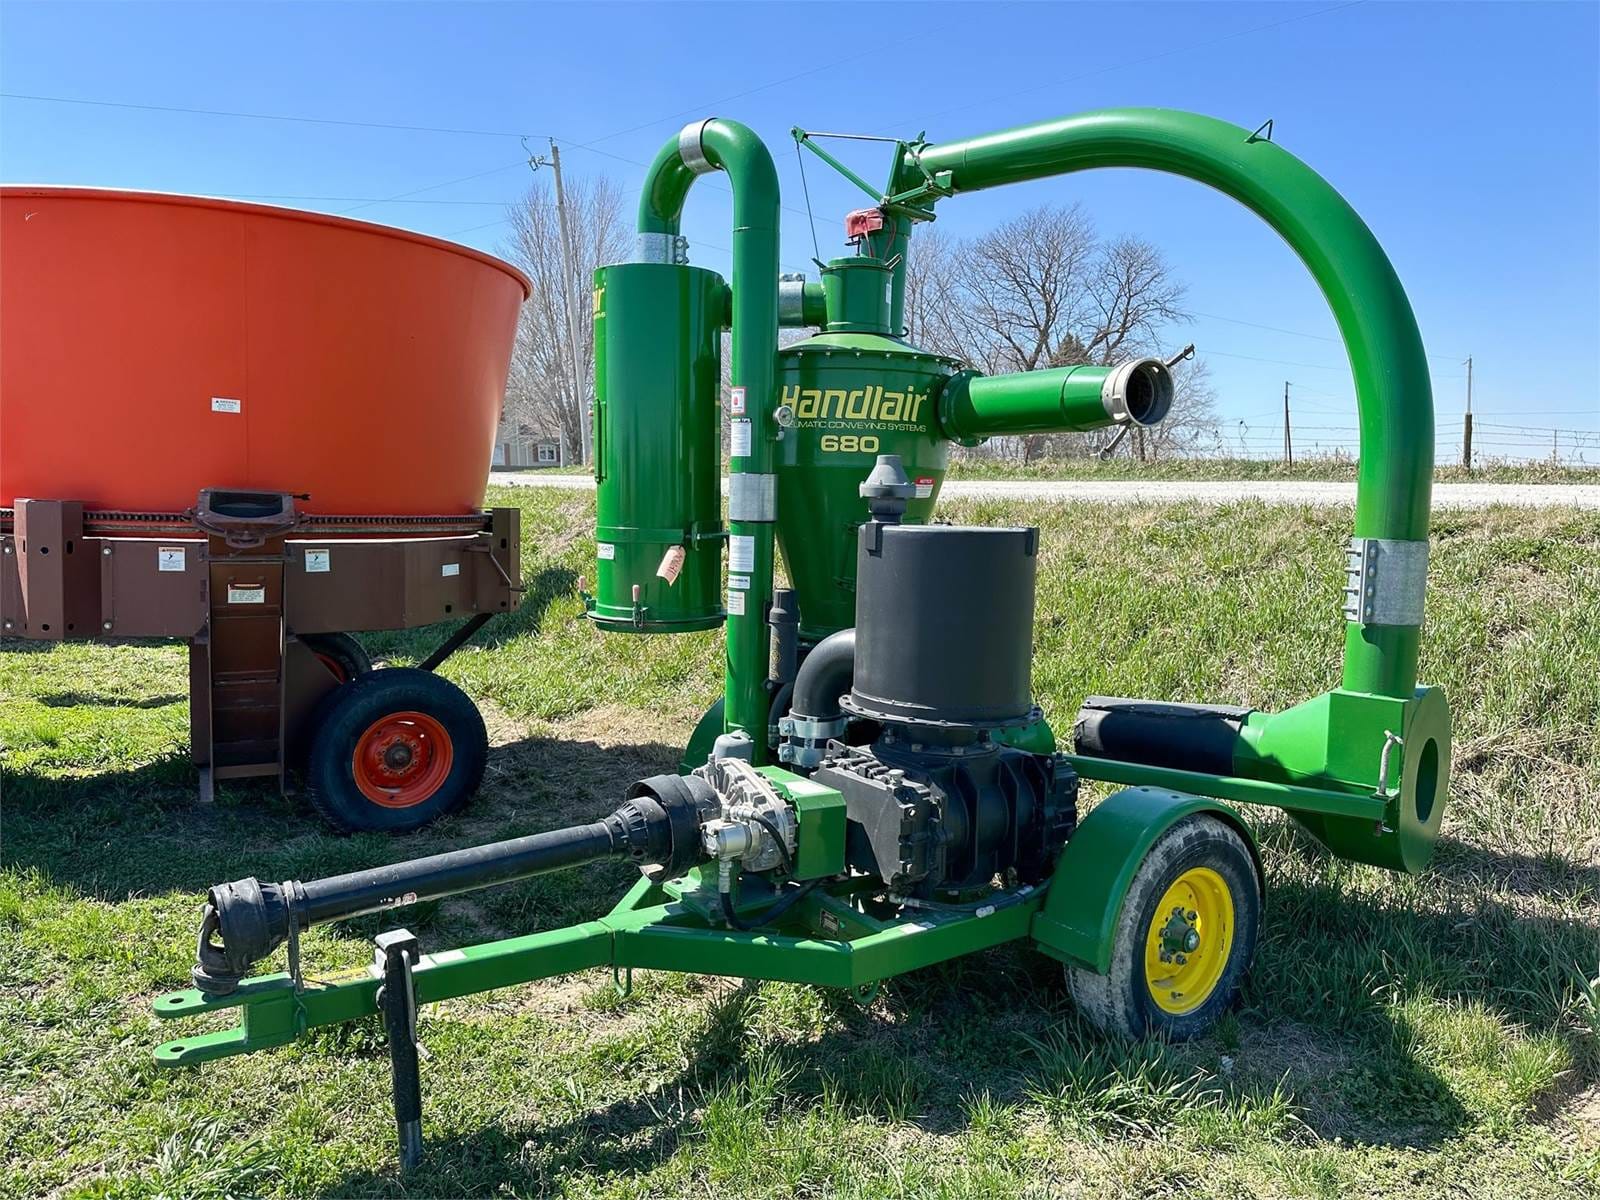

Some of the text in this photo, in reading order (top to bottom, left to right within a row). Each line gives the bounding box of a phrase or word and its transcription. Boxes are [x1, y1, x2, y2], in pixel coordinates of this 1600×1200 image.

[781, 385, 927, 422] Handlair
[828, 421, 886, 431] CONVEYING
[887, 422, 927, 433] SYSTEMS
[820, 435, 880, 453] 680
